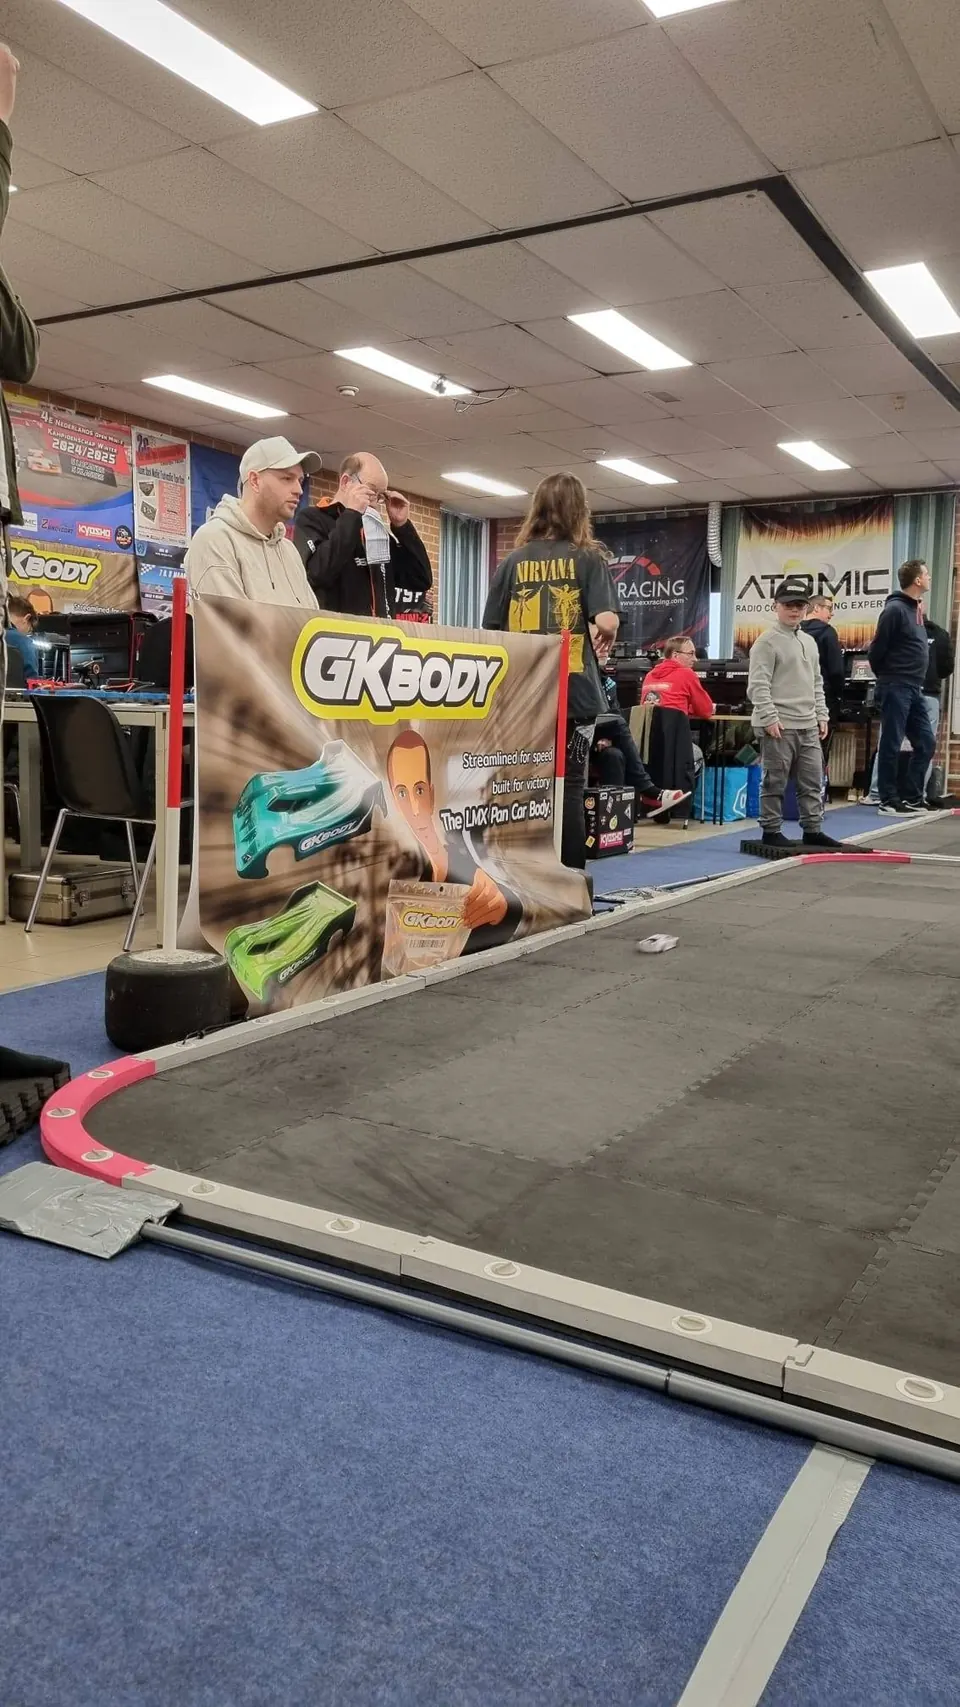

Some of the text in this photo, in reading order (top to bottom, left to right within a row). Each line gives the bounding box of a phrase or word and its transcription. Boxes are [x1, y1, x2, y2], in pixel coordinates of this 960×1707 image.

[52, 438, 116, 465] 2024/2025
[11, 551, 97, 584] KBODY
[515, 558, 576, 584] NIRVANA
[617, 580, 685, 598] RACING
[737, 569, 890, 600] ATOMIC
[620, 599, 685, 607] www.nexxracing.com
[736, 604, 762, 612] RADIO
[303, 635, 503, 709] GKBODY
[462, 749, 553, 769] Streamlined for speed
[492, 780, 511, 795] built
[513, 779, 524, 792] for
[441, 799, 551, 831] The LMX Pan Car Body.
[300, 820, 357, 852] GKBODY
[403, 911, 461, 929] GKBODY
[278, 947, 318, 981] GKBODY
